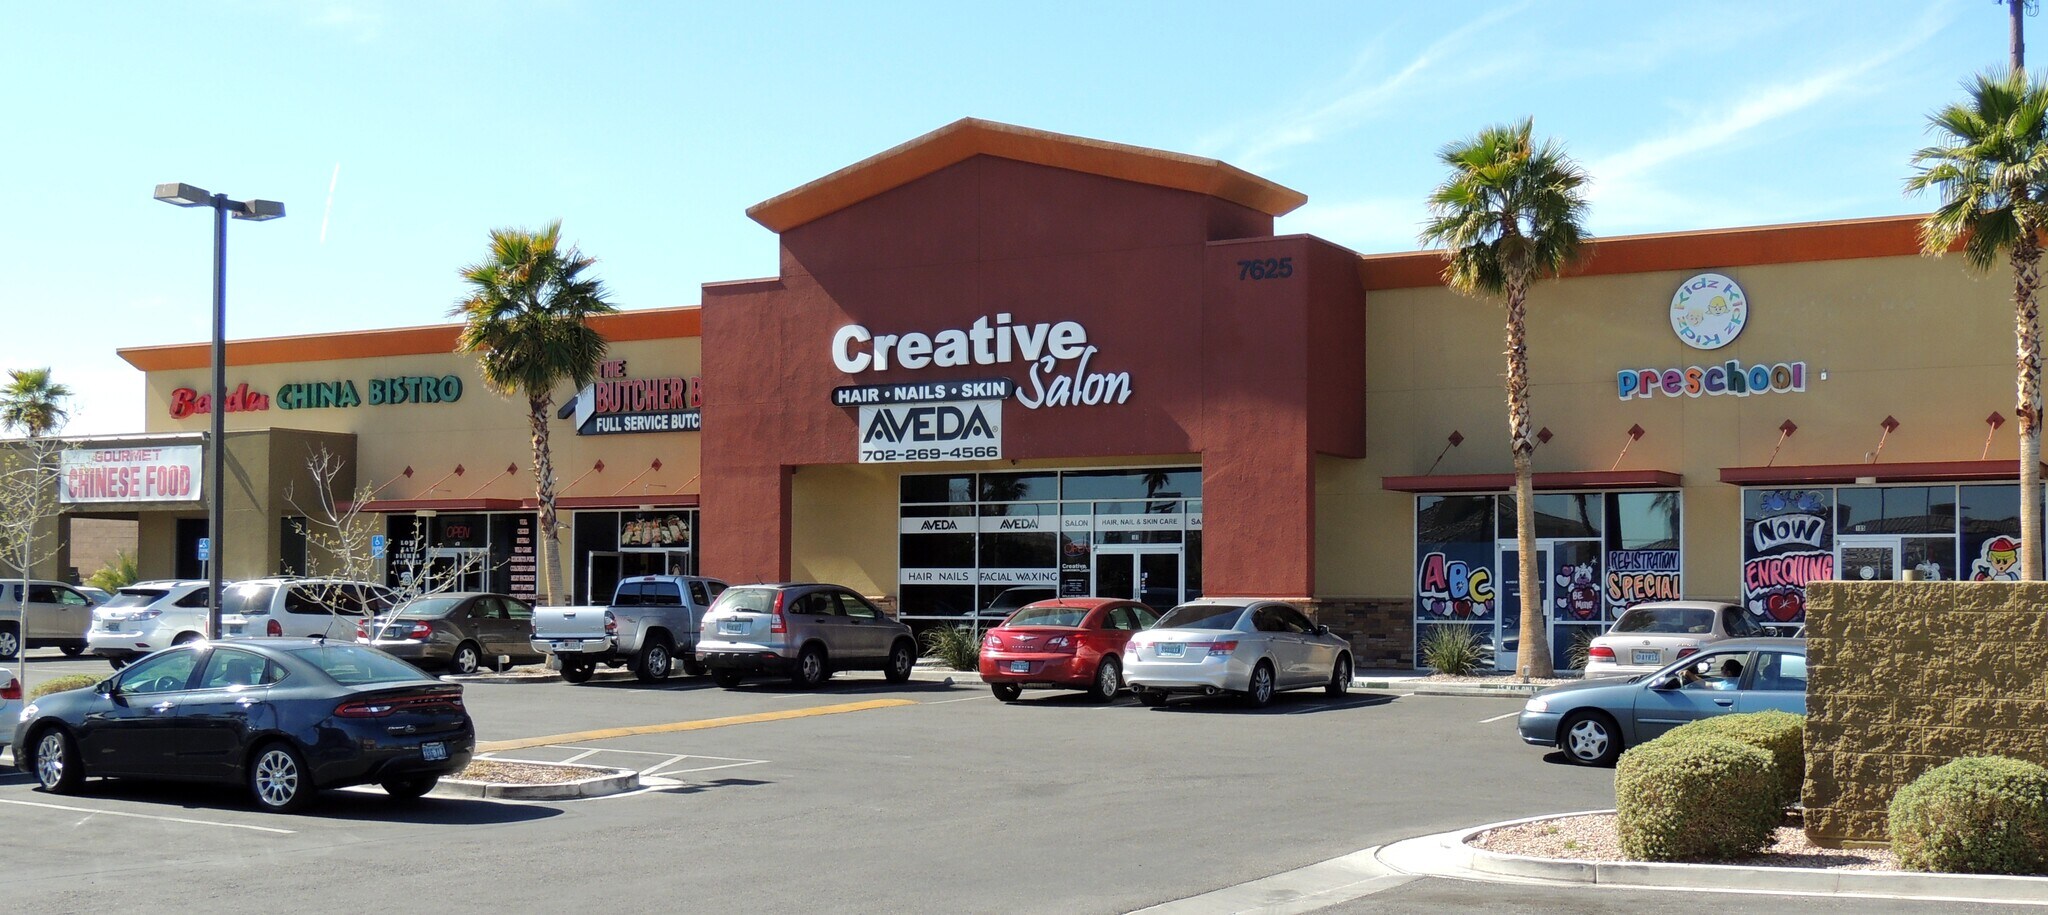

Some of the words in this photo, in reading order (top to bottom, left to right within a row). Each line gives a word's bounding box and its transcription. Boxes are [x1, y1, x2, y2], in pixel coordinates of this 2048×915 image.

[1237, 257, 1293, 280] 7625
[1674, 277, 1719, 310] Kidz
[831, 312, 1088, 374] Creative
[599, 360, 624, 378] THE
[1015, 344, 1132, 410] Salon
[1617, 360, 1806, 400] preschool
[169, 383, 270, 420] Badu
[276, 380, 361, 410] CHINA
[368, 375, 463, 406] BISTRO
[596, 377, 684, 413] BUTCHER
[838, 388, 880, 404] HAIR
[894, 384, 946, 400] NAILS
[961, 381, 1006, 397] SKIN
[596, 416, 622, 432] FULL
[624, 414, 668, 431] SERVICE
[862, 403, 995, 444] AVEDA
[95, 449, 162, 463] GOURMET
[862, 446, 998, 461] 702-269-4566
[68, 466, 141, 498] CHINESE
[145, 465, 191, 497] FOOD
[446, 526, 470, 538] OPEN
[920, 519, 958, 530] AVEDA
[1000, 518, 1039, 530] AVEDA
[1065, 519, 1088, 527] SALON
[1758, 519, 1821, 545] NOW
[1611, 551, 1678, 570] REGISTRATION
[908, 571, 933, 581] HAIR
[938, 571, 969, 581] NAILS
[980, 571, 1012, 581] FACIAL
[1016, 571, 1057, 581] WAXING
[1425, 554, 1494, 602] ABC
[1609, 572, 1680, 600] SPECIAL
[1572, 591, 1584, 600] BE
